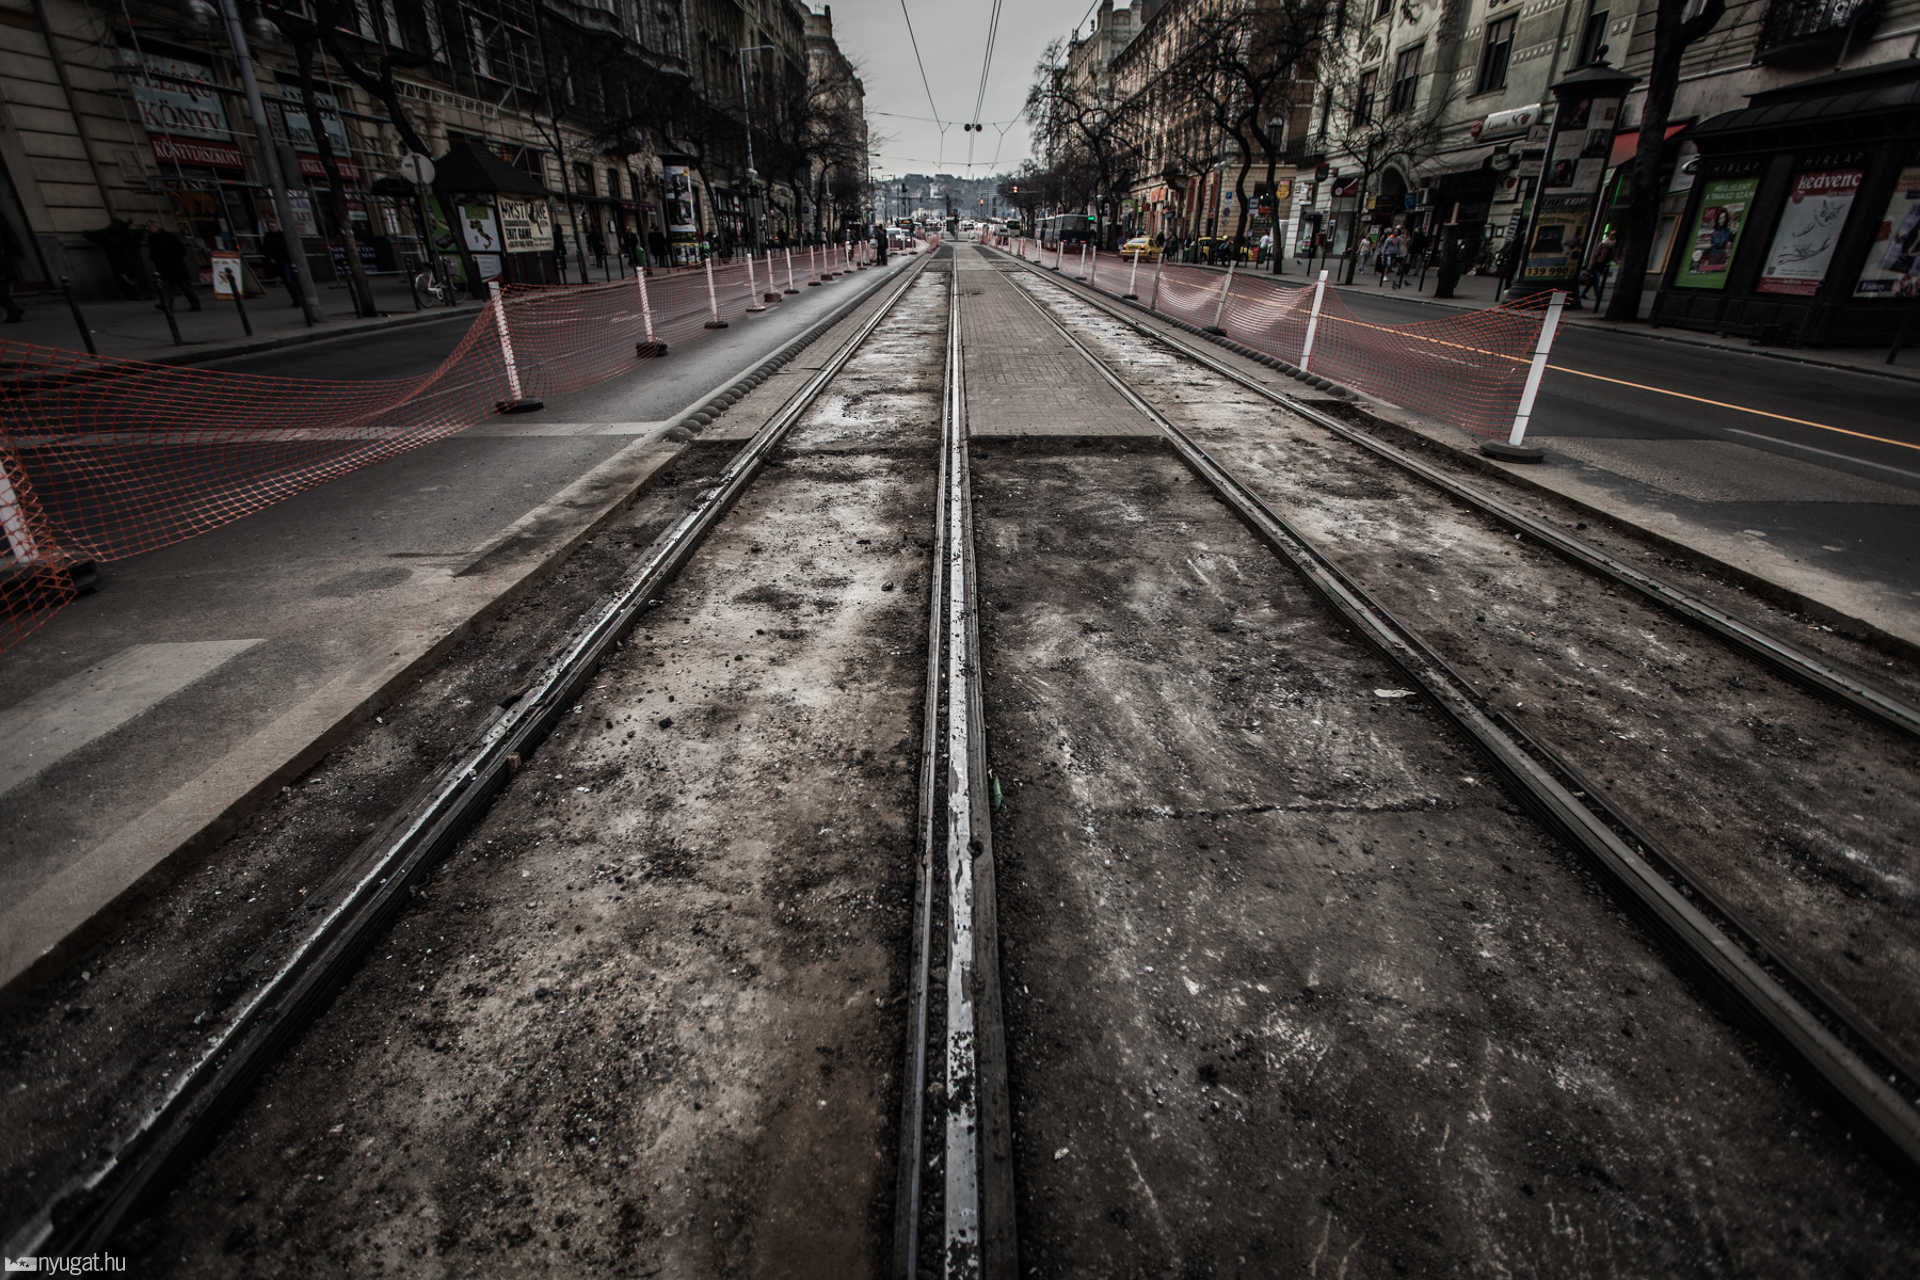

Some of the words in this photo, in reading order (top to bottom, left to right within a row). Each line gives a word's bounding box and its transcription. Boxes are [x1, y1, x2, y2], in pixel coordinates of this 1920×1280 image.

[143, 99, 221, 132] KÖNYV
[1797, 171, 1863, 190] kedvenc
[500, 199, 548, 219] MYSTIUE
